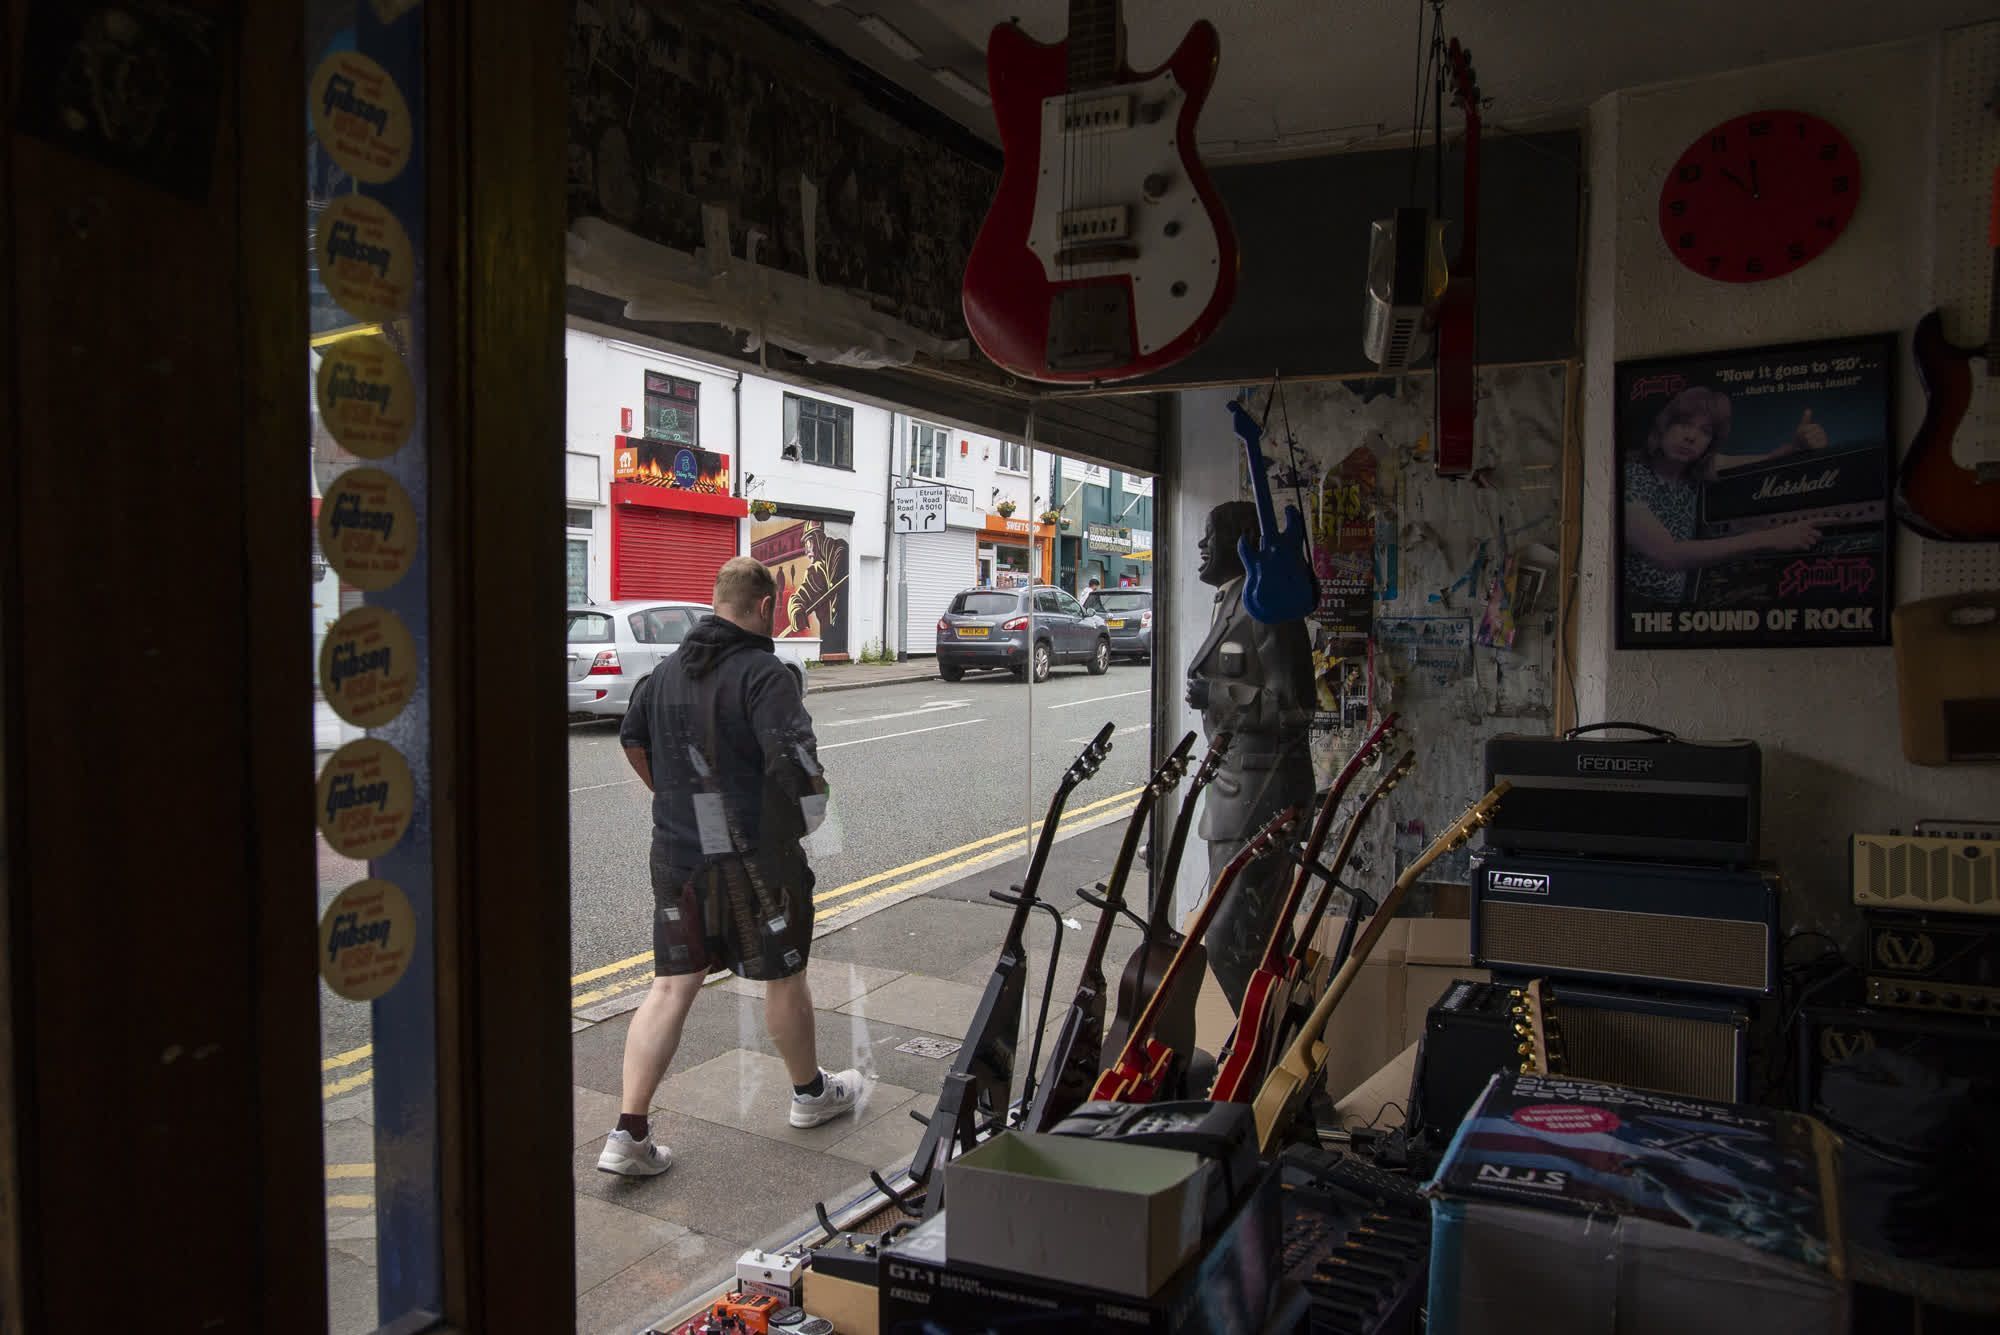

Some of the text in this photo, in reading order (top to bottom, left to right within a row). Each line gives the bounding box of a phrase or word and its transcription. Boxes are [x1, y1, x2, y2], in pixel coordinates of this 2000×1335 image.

[1758, 366, 1770, 378] it
[1775, 364, 1808, 380] goes
[1812, 361, 1828, 373] to
[1752, 469, 1840, 501] Marshall
[1632, 607, 1874, 632] THE SOUND OF ROCK
[331, 640, 391, 692] Gibson
[1579, 755, 1653, 774] FENDER
[326, 774, 389, 825] Gibson
[1493, 873, 1544, 891] Laney
[327, 912, 391, 963] Gibson
[1516, 1076, 1640, 1095] DIGITAL
[1511, 1090, 1769, 1127] KEYBOARD KIT
[889, 1263, 936, 1286] GT-1
